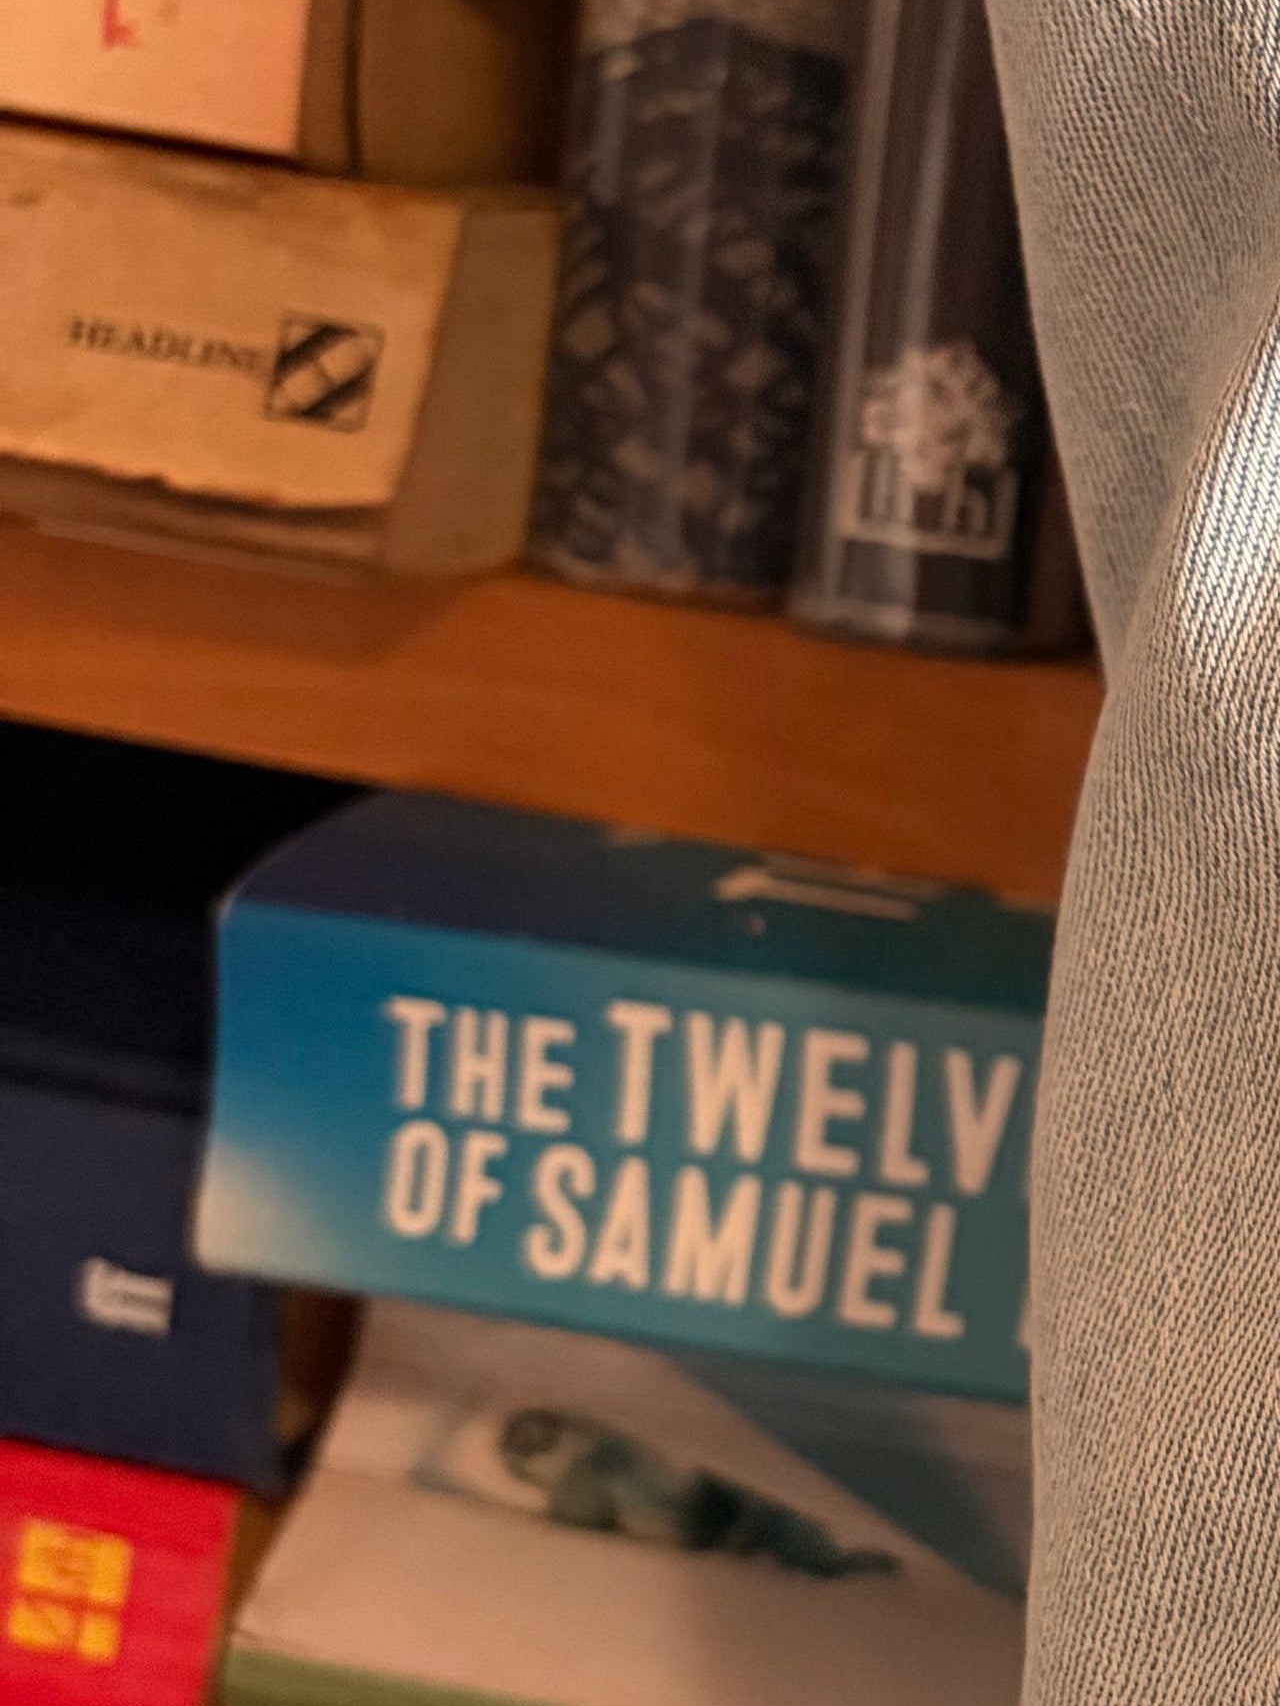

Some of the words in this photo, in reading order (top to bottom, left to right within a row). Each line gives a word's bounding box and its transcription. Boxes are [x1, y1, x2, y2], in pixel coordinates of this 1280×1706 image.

[382, 992, 578, 1135] THE
[604, 999, 1028, 1198] TWELV
[385, 1120, 509, 1246] OF
[520, 1143, 968, 1341] SAMUEL
